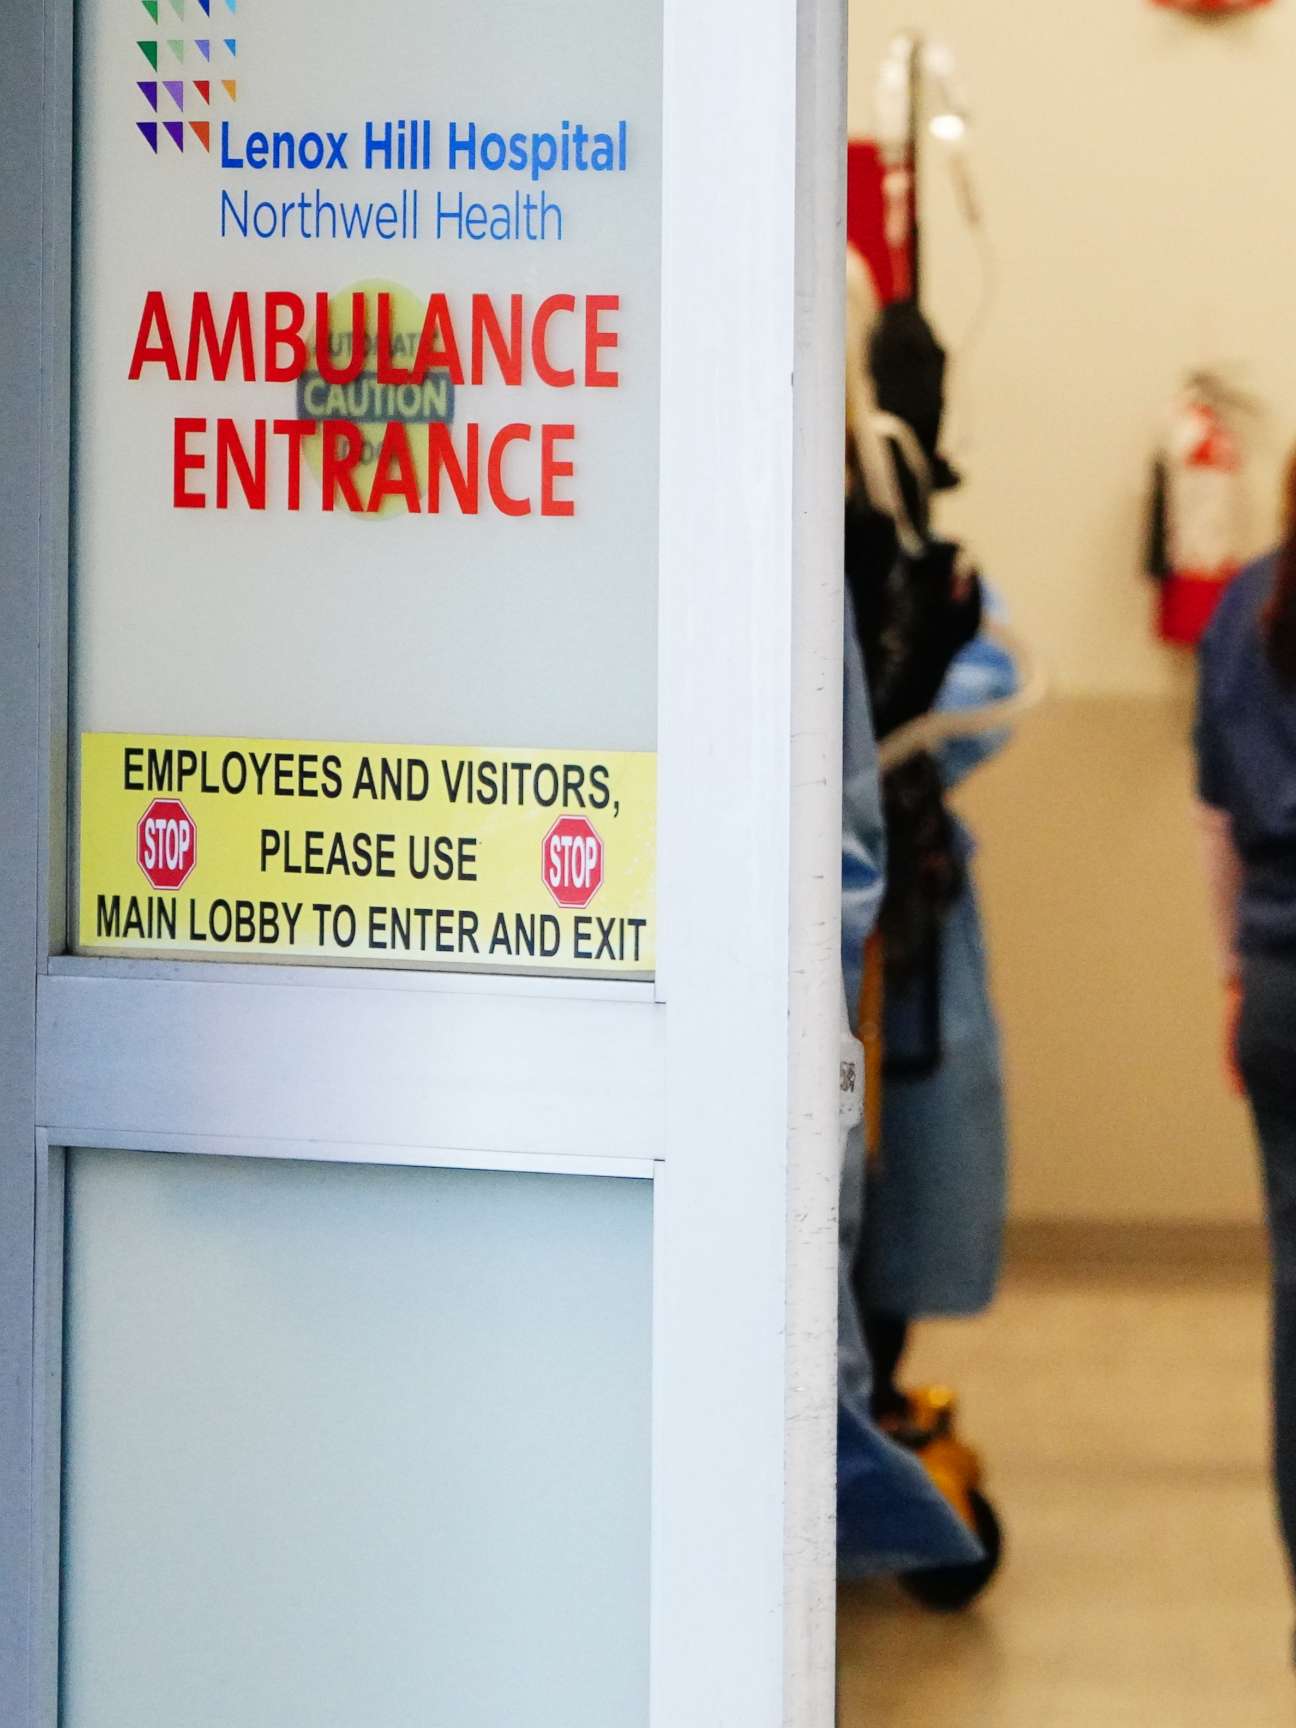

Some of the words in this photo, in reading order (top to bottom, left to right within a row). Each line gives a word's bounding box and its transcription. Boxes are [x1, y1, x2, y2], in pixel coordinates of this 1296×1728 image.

[221, 120, 349, 170] Lenox
[365, 119, 431, 170] Hill
[448, 119, 627, 182] Hospital
[221, 188, 418, 240] Northwell
[436, 189, 562, 241] Health
[128, 290, 619, 388] AMBULANCE
[303, 377, 448, 418] CAUTION
[173, 417, 576, 517] ENTRANCE
[123, 747, 343, 799] EMPLOYEES
[352, 756, 430, 802] AND
[441, 759, 620, 818] VISITORS,
[144, 817, 190, 870] STOP
[260, 828, 396, 878] PLEASE
[409, 834, 478, 882] USE
[549, 834, 598, 889] STOP
[96, 894, 177, 940] MAIN
[189, 897, 303, 945] LOBBY
[312, 903, 356, 948] TO
[368, 906, 480, 954] ENTER
[488, 912, 561, 958] AND
[573, 915, 647, 962] EXIT
